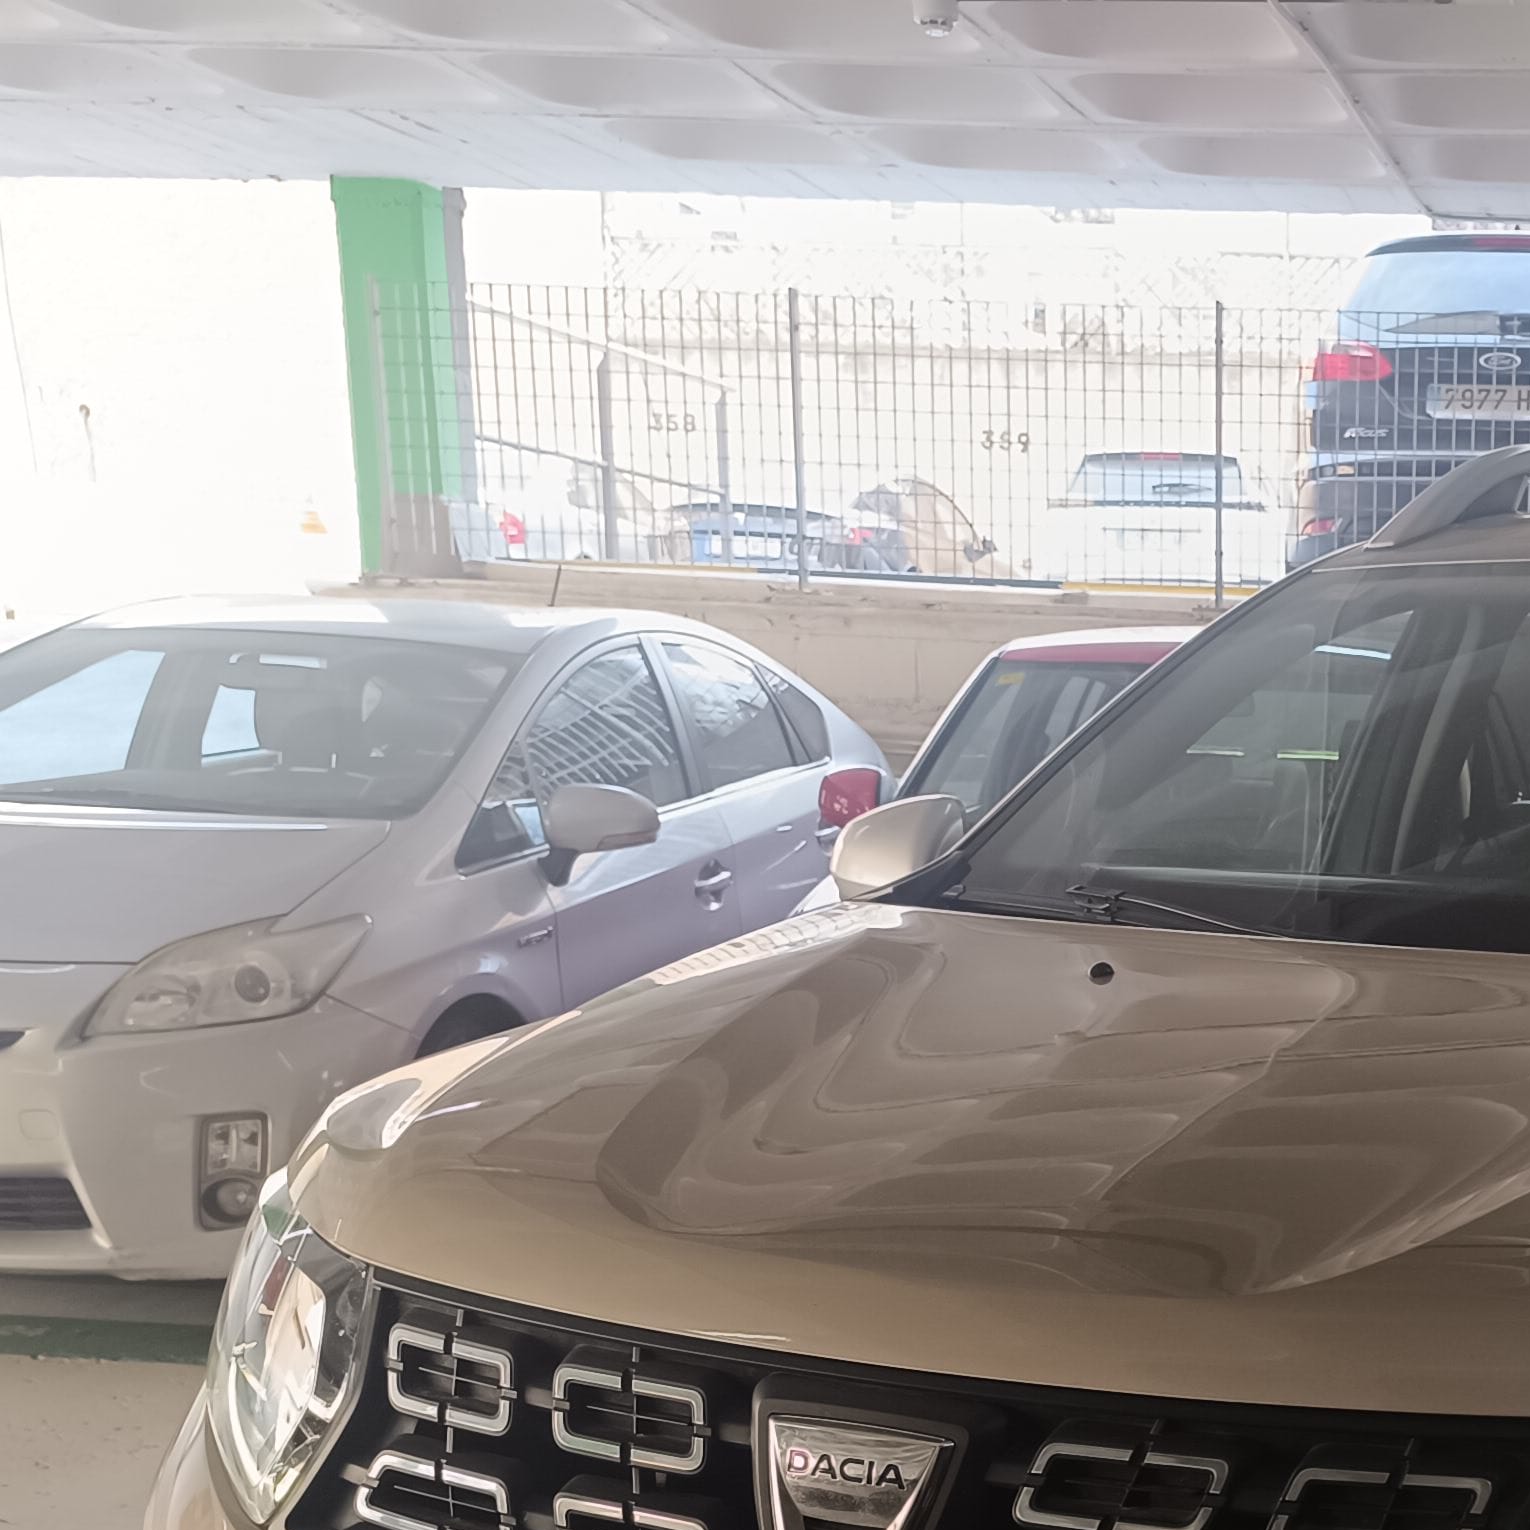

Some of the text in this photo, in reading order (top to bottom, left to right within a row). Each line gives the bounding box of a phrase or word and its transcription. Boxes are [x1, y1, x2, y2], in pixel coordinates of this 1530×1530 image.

[1443, 387, 1508, 411] 7977
[649, 413, 696, 432] 358
[981, 430, 1029, 453] 359
[787, 1449, 906, 1490] DACIA
